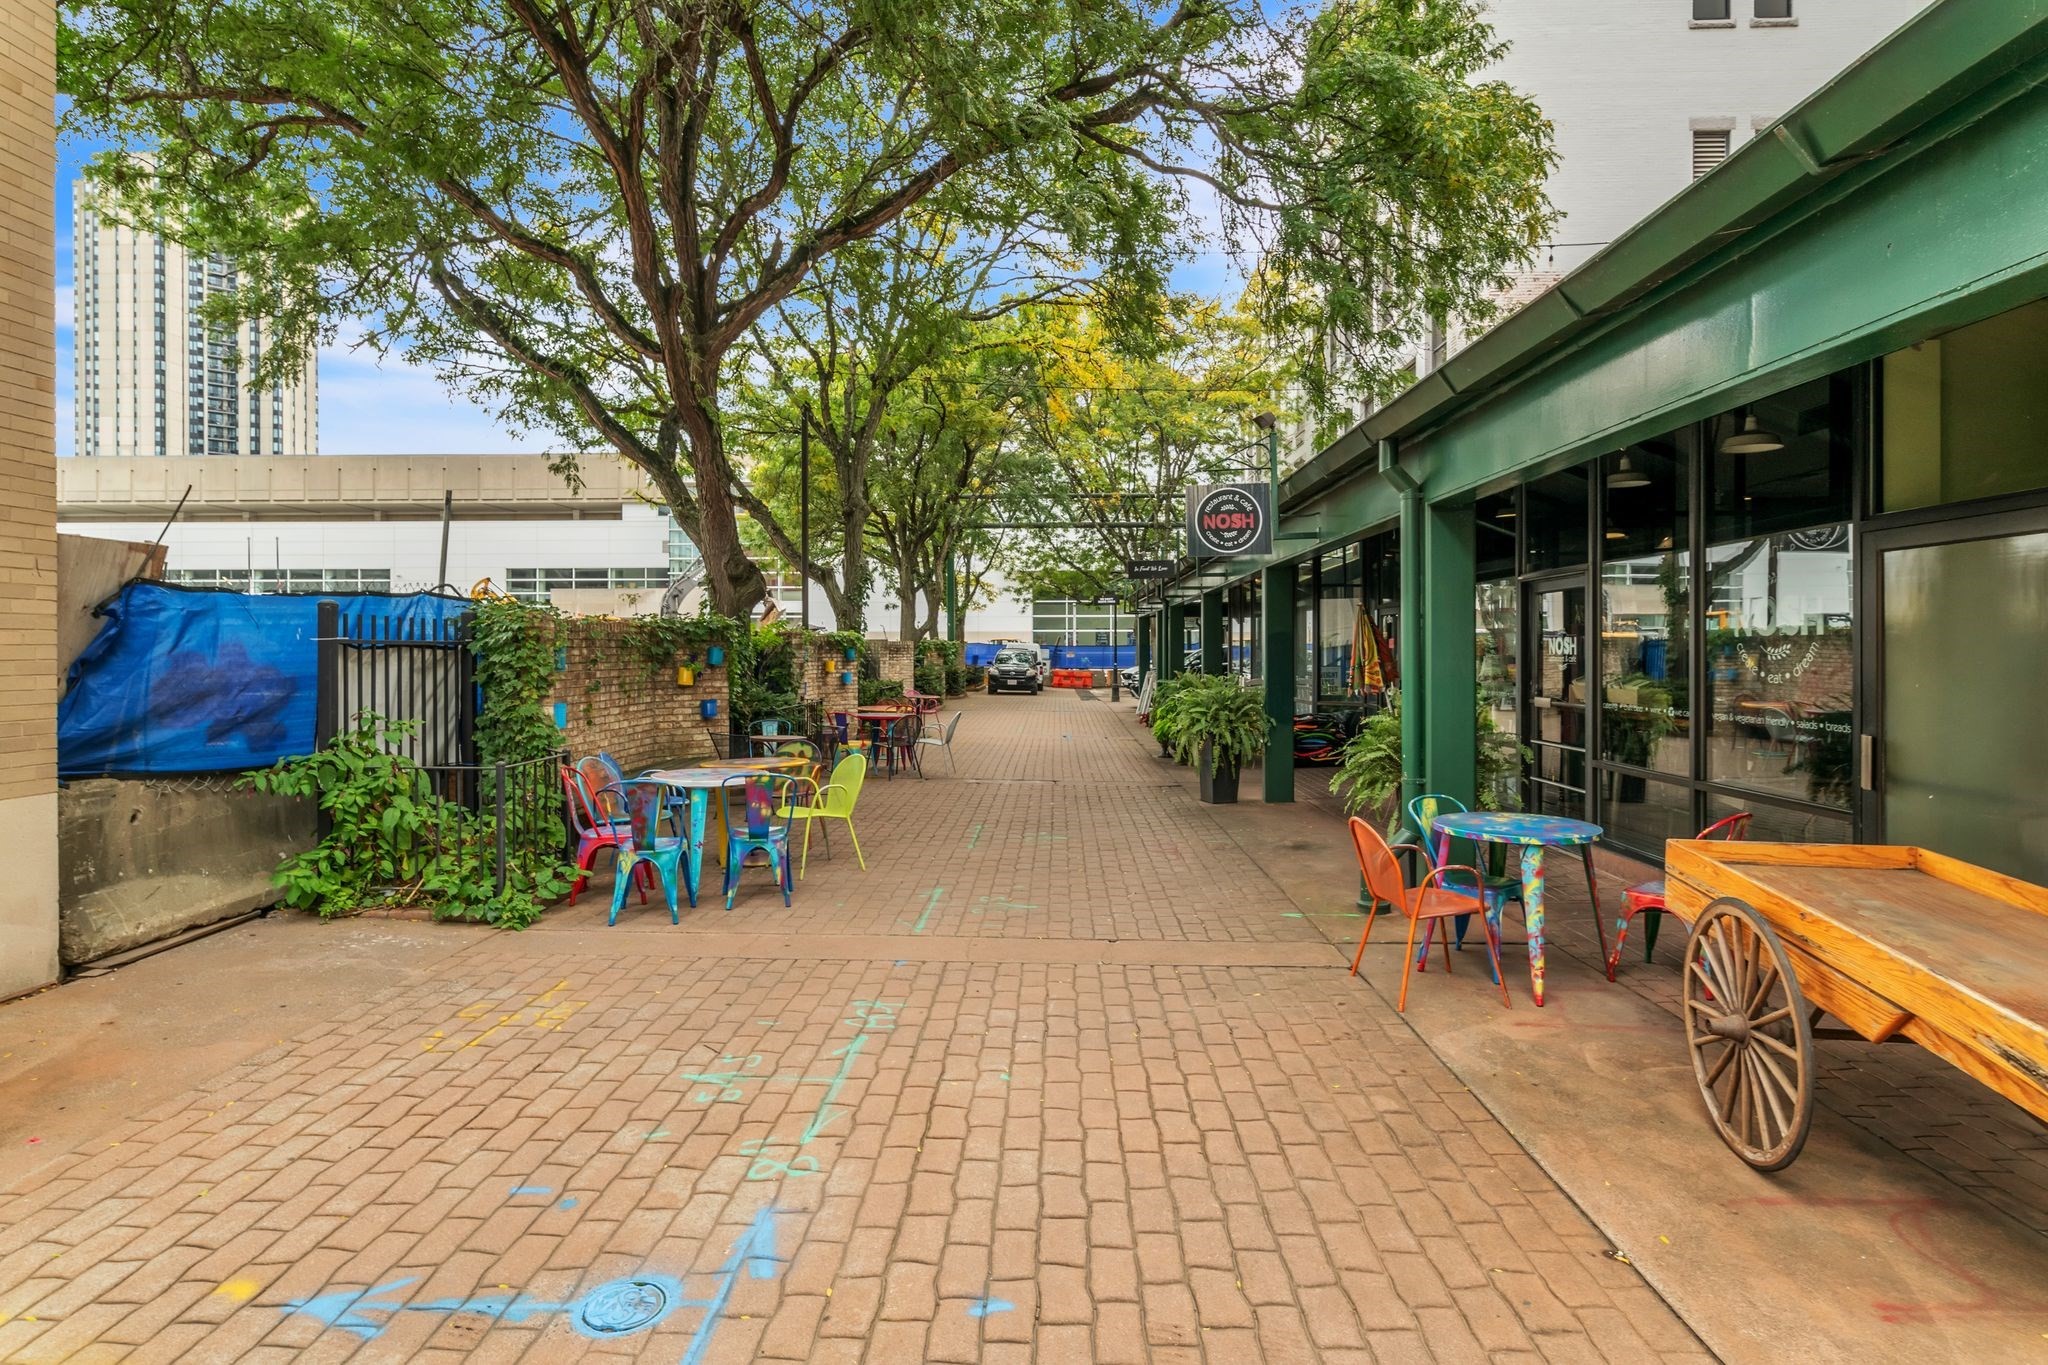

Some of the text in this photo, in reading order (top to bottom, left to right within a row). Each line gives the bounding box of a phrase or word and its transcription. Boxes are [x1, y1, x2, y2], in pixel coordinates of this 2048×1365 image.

[1204, 494, 1233, 513] restaurant
[1233, 494, 1240, 502] &
[1203, 513, 1255, 529] NOSH
[1205, 530, 1220, 545] create
[1238, 529, 1253, 544] dream
[1548, 636, 1577, 656] NOSH
[1736, 641, 1820, 684] create eat dream
[1796, 719, 1818, 730] salads
[1825, 721, 1852, 733] breads
